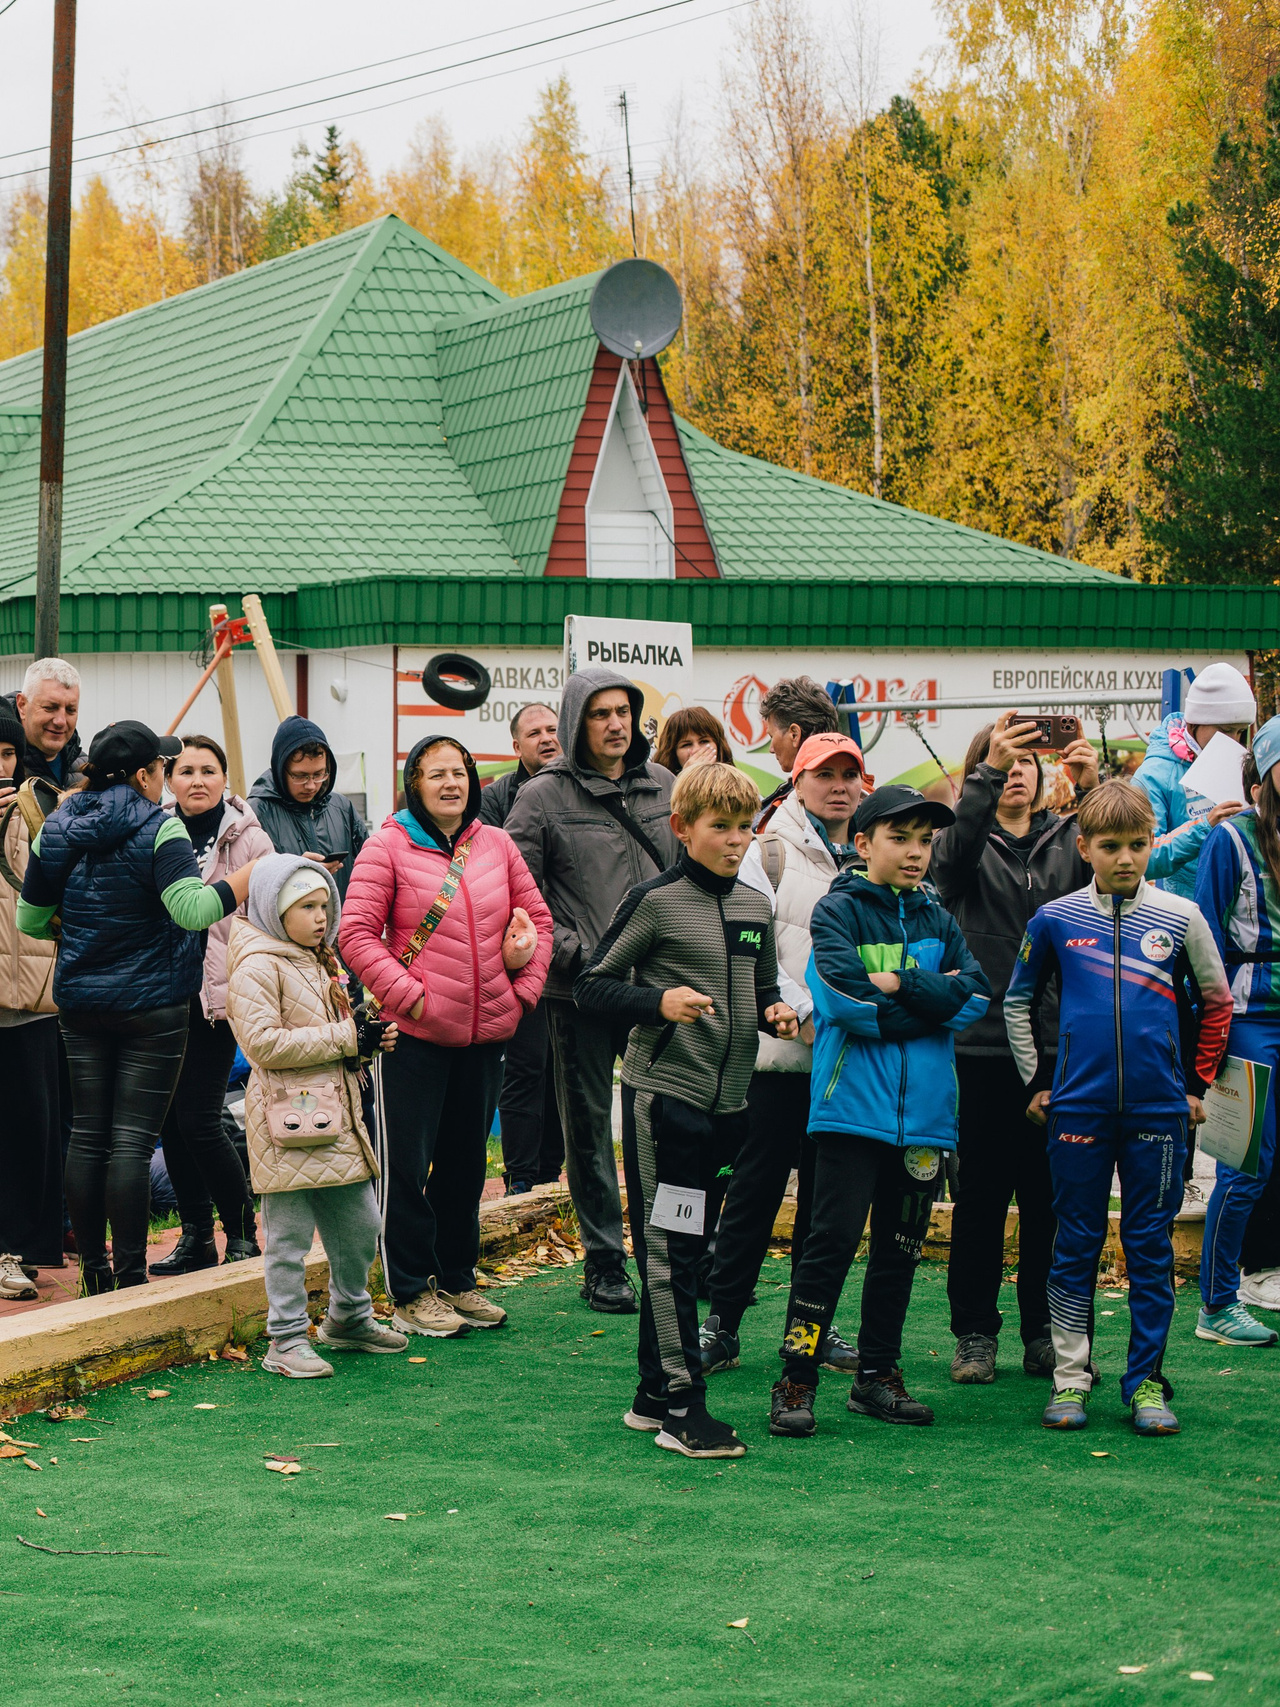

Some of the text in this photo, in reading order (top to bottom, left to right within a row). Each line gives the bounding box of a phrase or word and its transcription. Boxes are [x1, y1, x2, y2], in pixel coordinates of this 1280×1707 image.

[587, 640, 683, 667] РЫБАЛКА
[486, 667, 564, 689] АВКАЗ
[993, 666, 1117, 690] ЕВРОПЕЙСКАЯ
[739, 930, 761, 943] FILA
[1138, 1132, 1173, 1142] ЮГРА
[675, 1203, 692, 1219] 10
